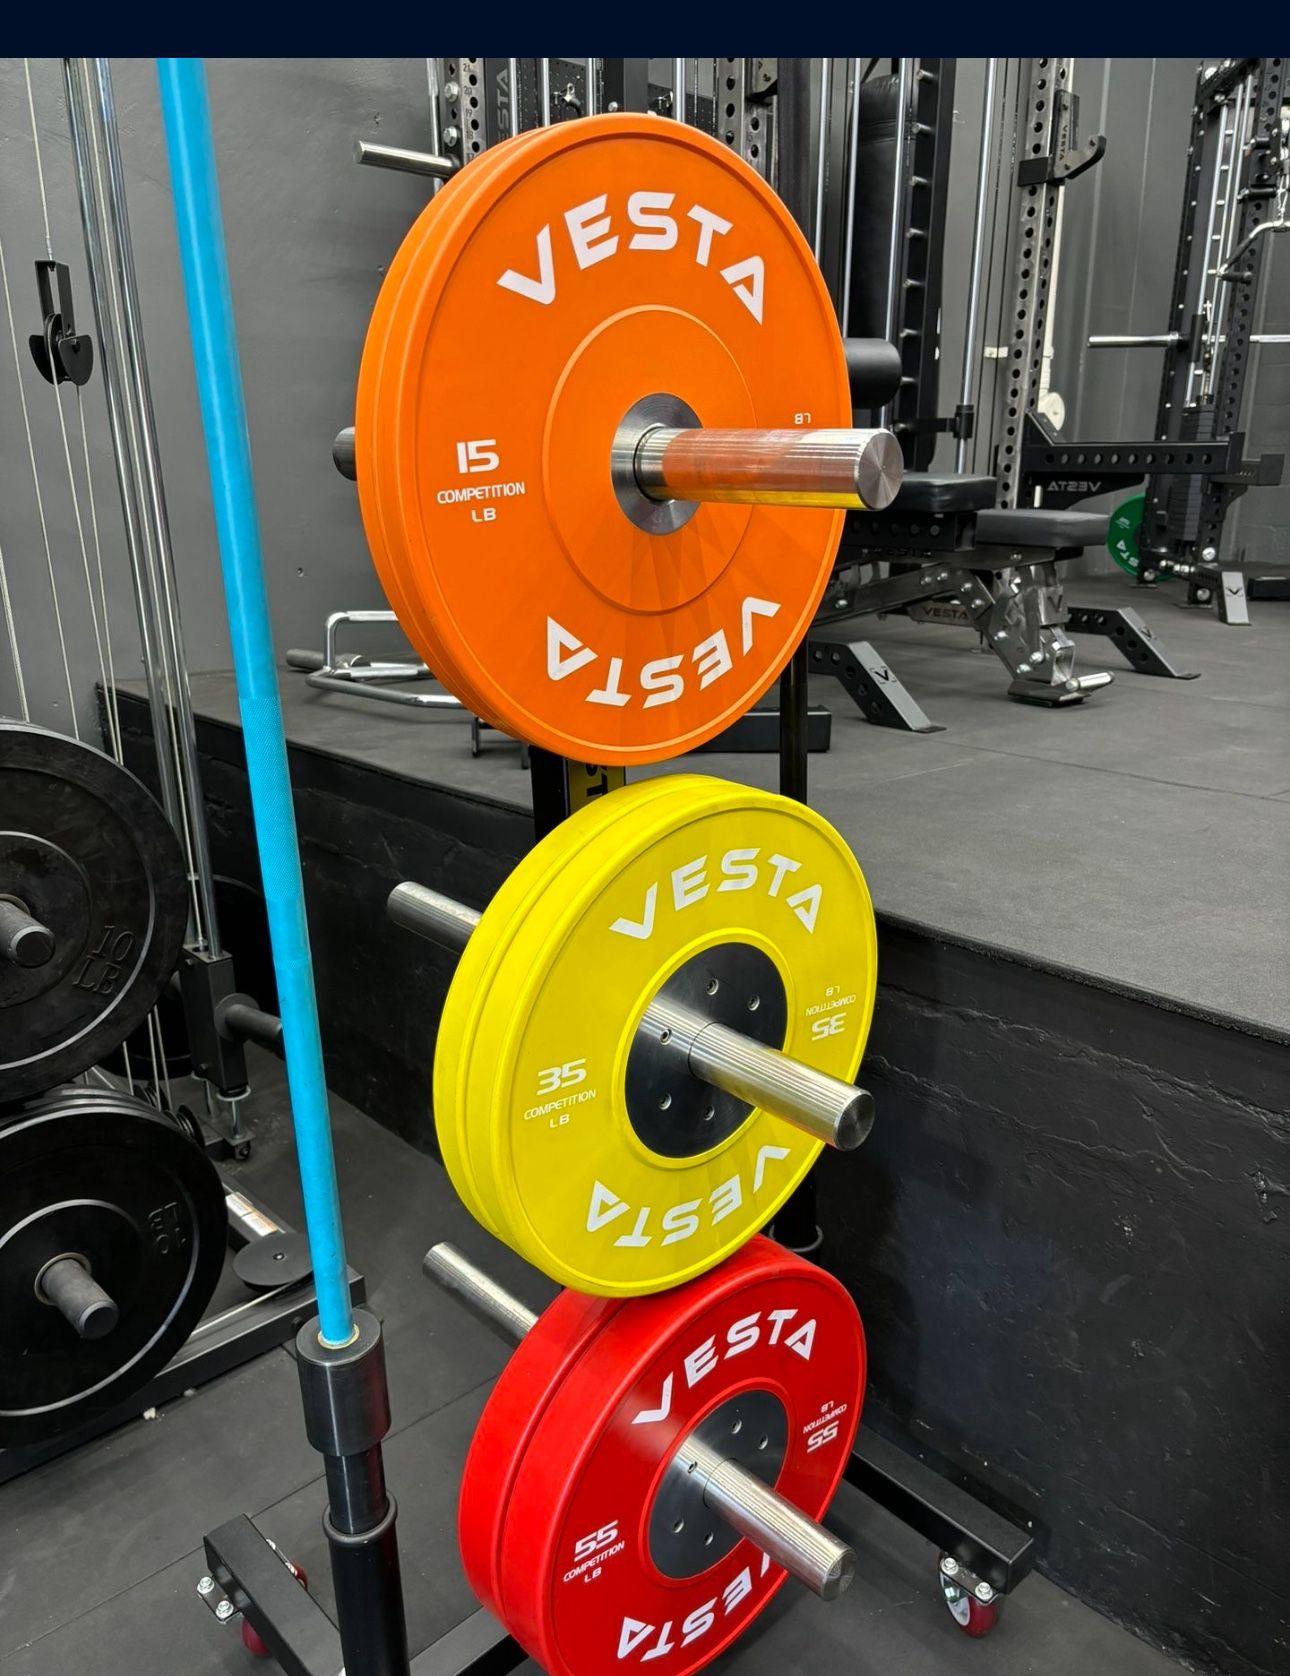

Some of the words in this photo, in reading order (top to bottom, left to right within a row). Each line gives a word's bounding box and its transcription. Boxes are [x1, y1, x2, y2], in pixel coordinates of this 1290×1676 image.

[496, 68, 509, 140] STA
[496, 191, 765, 326] VESTA
[794, 412, 811, 425] LB
[456, 439, 500, 474] 15
[437, 481, 526, 504] COMPETITION
[471, 507, 497, 523] LB
[922, 607, 969, 620] VESTA
[546, 596, 781, 709] VESTA
[608, 848, 823, 939] VESTA
[92, 925, 134, 961] 10
[72, 955, 121, 994] LB
[825, 986, 840, 996] LB
[805, 994, 856, 1016] COMPETITION
[811, 1012, 847, 1041] 35
[536, 1058, 586, 1095] 35
[523, 1089, 597, 1120] COMPETITION
[549, 1114, 570, 1128] LB
[586, 1145, 791, 1247] VESTA
[632, 1309, 816, 1425] VESTA
[803, 1404, 847, 1434] COMPETITION
[821, 1400, 834, 1413] LB
[807, 1420, 839, 1453] 55
[574, 1520, 618, 1562] 55
[563, 1541, 625, 1582] COMPETITION
[584, 1567, 602, 1583] LB
